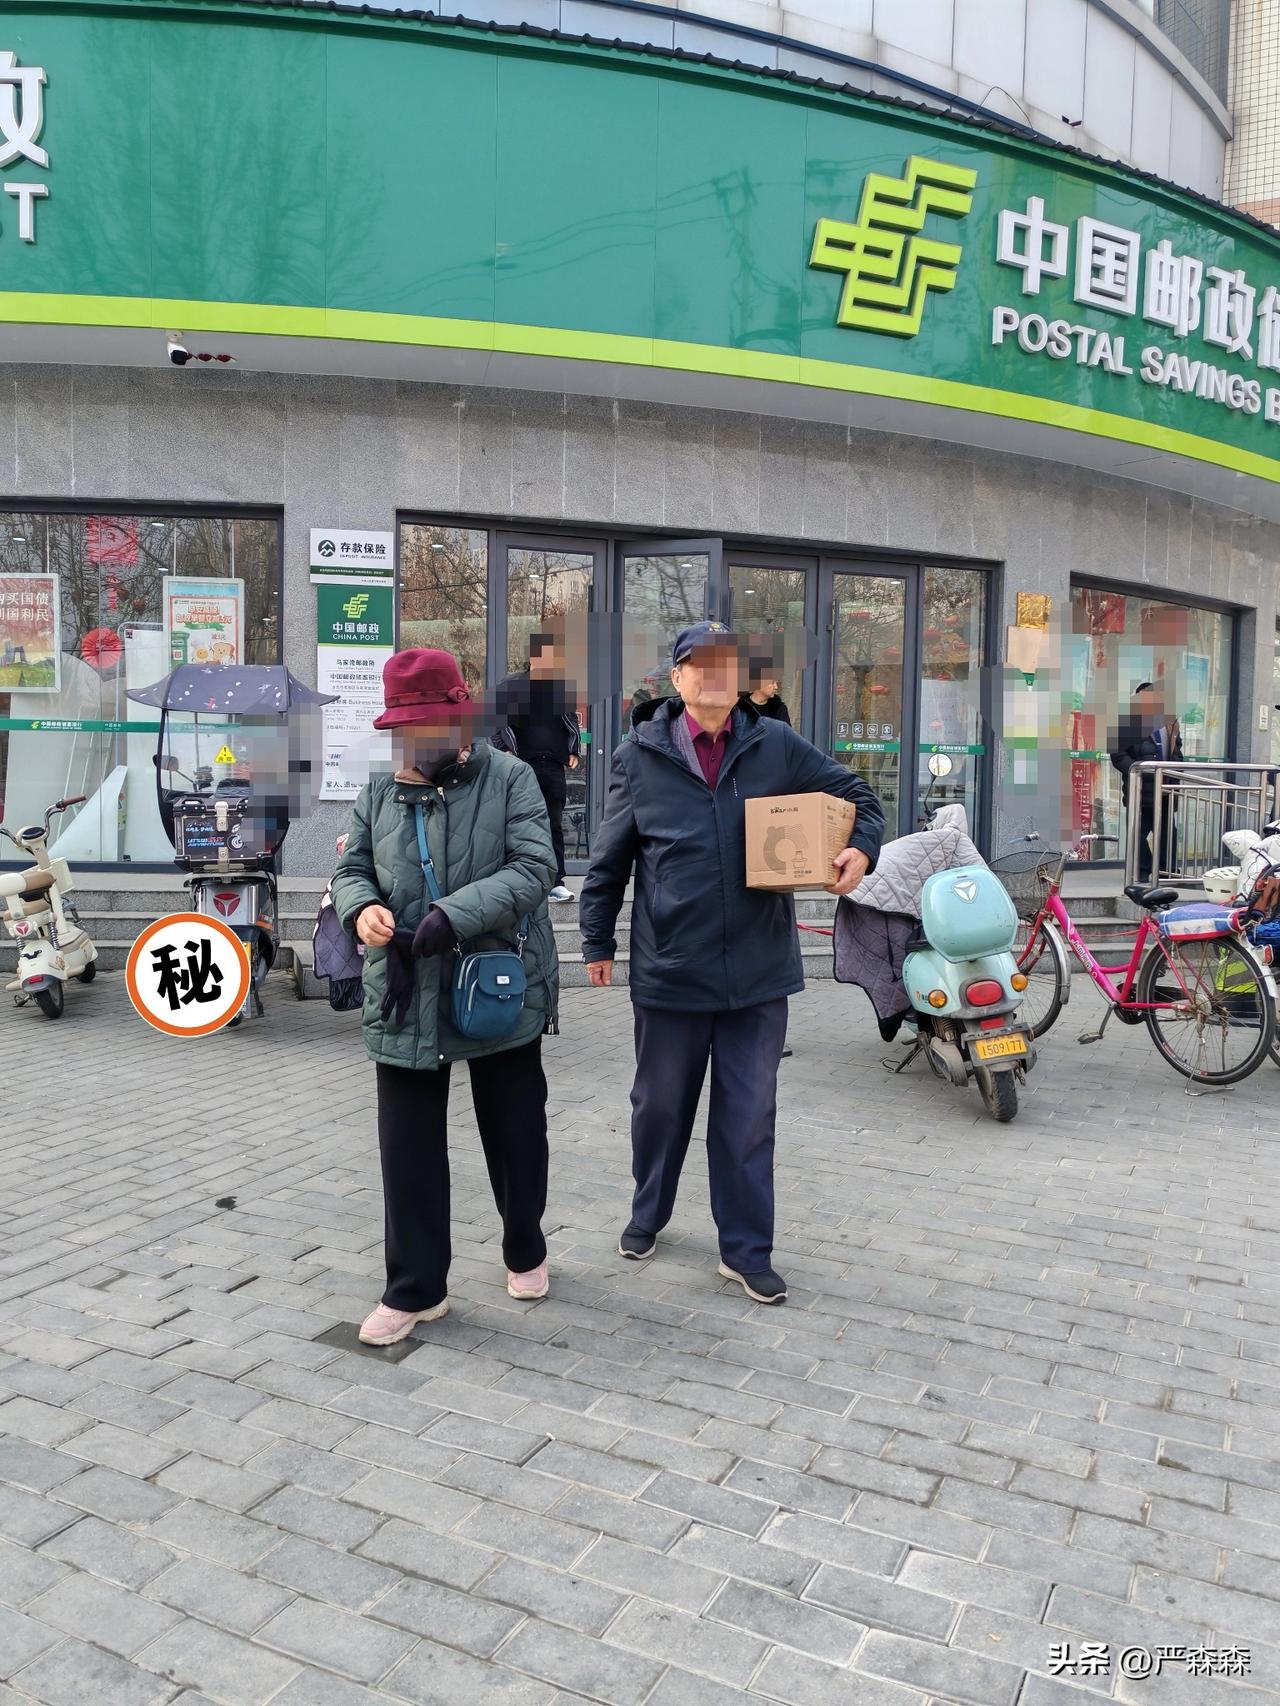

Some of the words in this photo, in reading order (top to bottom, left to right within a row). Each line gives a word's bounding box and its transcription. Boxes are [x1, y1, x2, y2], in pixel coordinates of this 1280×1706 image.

[0, 183, 48, 243] T
[991, 305, 1133, 376] POSTAL
[1140, 346, 1261, 415] SAVINGS
[340, 541, 386, 555] 存款保险
[332, 621, 379, 634] 中国邮政
[333, 633, 357, 641] CHINA
[982, 1040, 1022, 1056] 1509177
